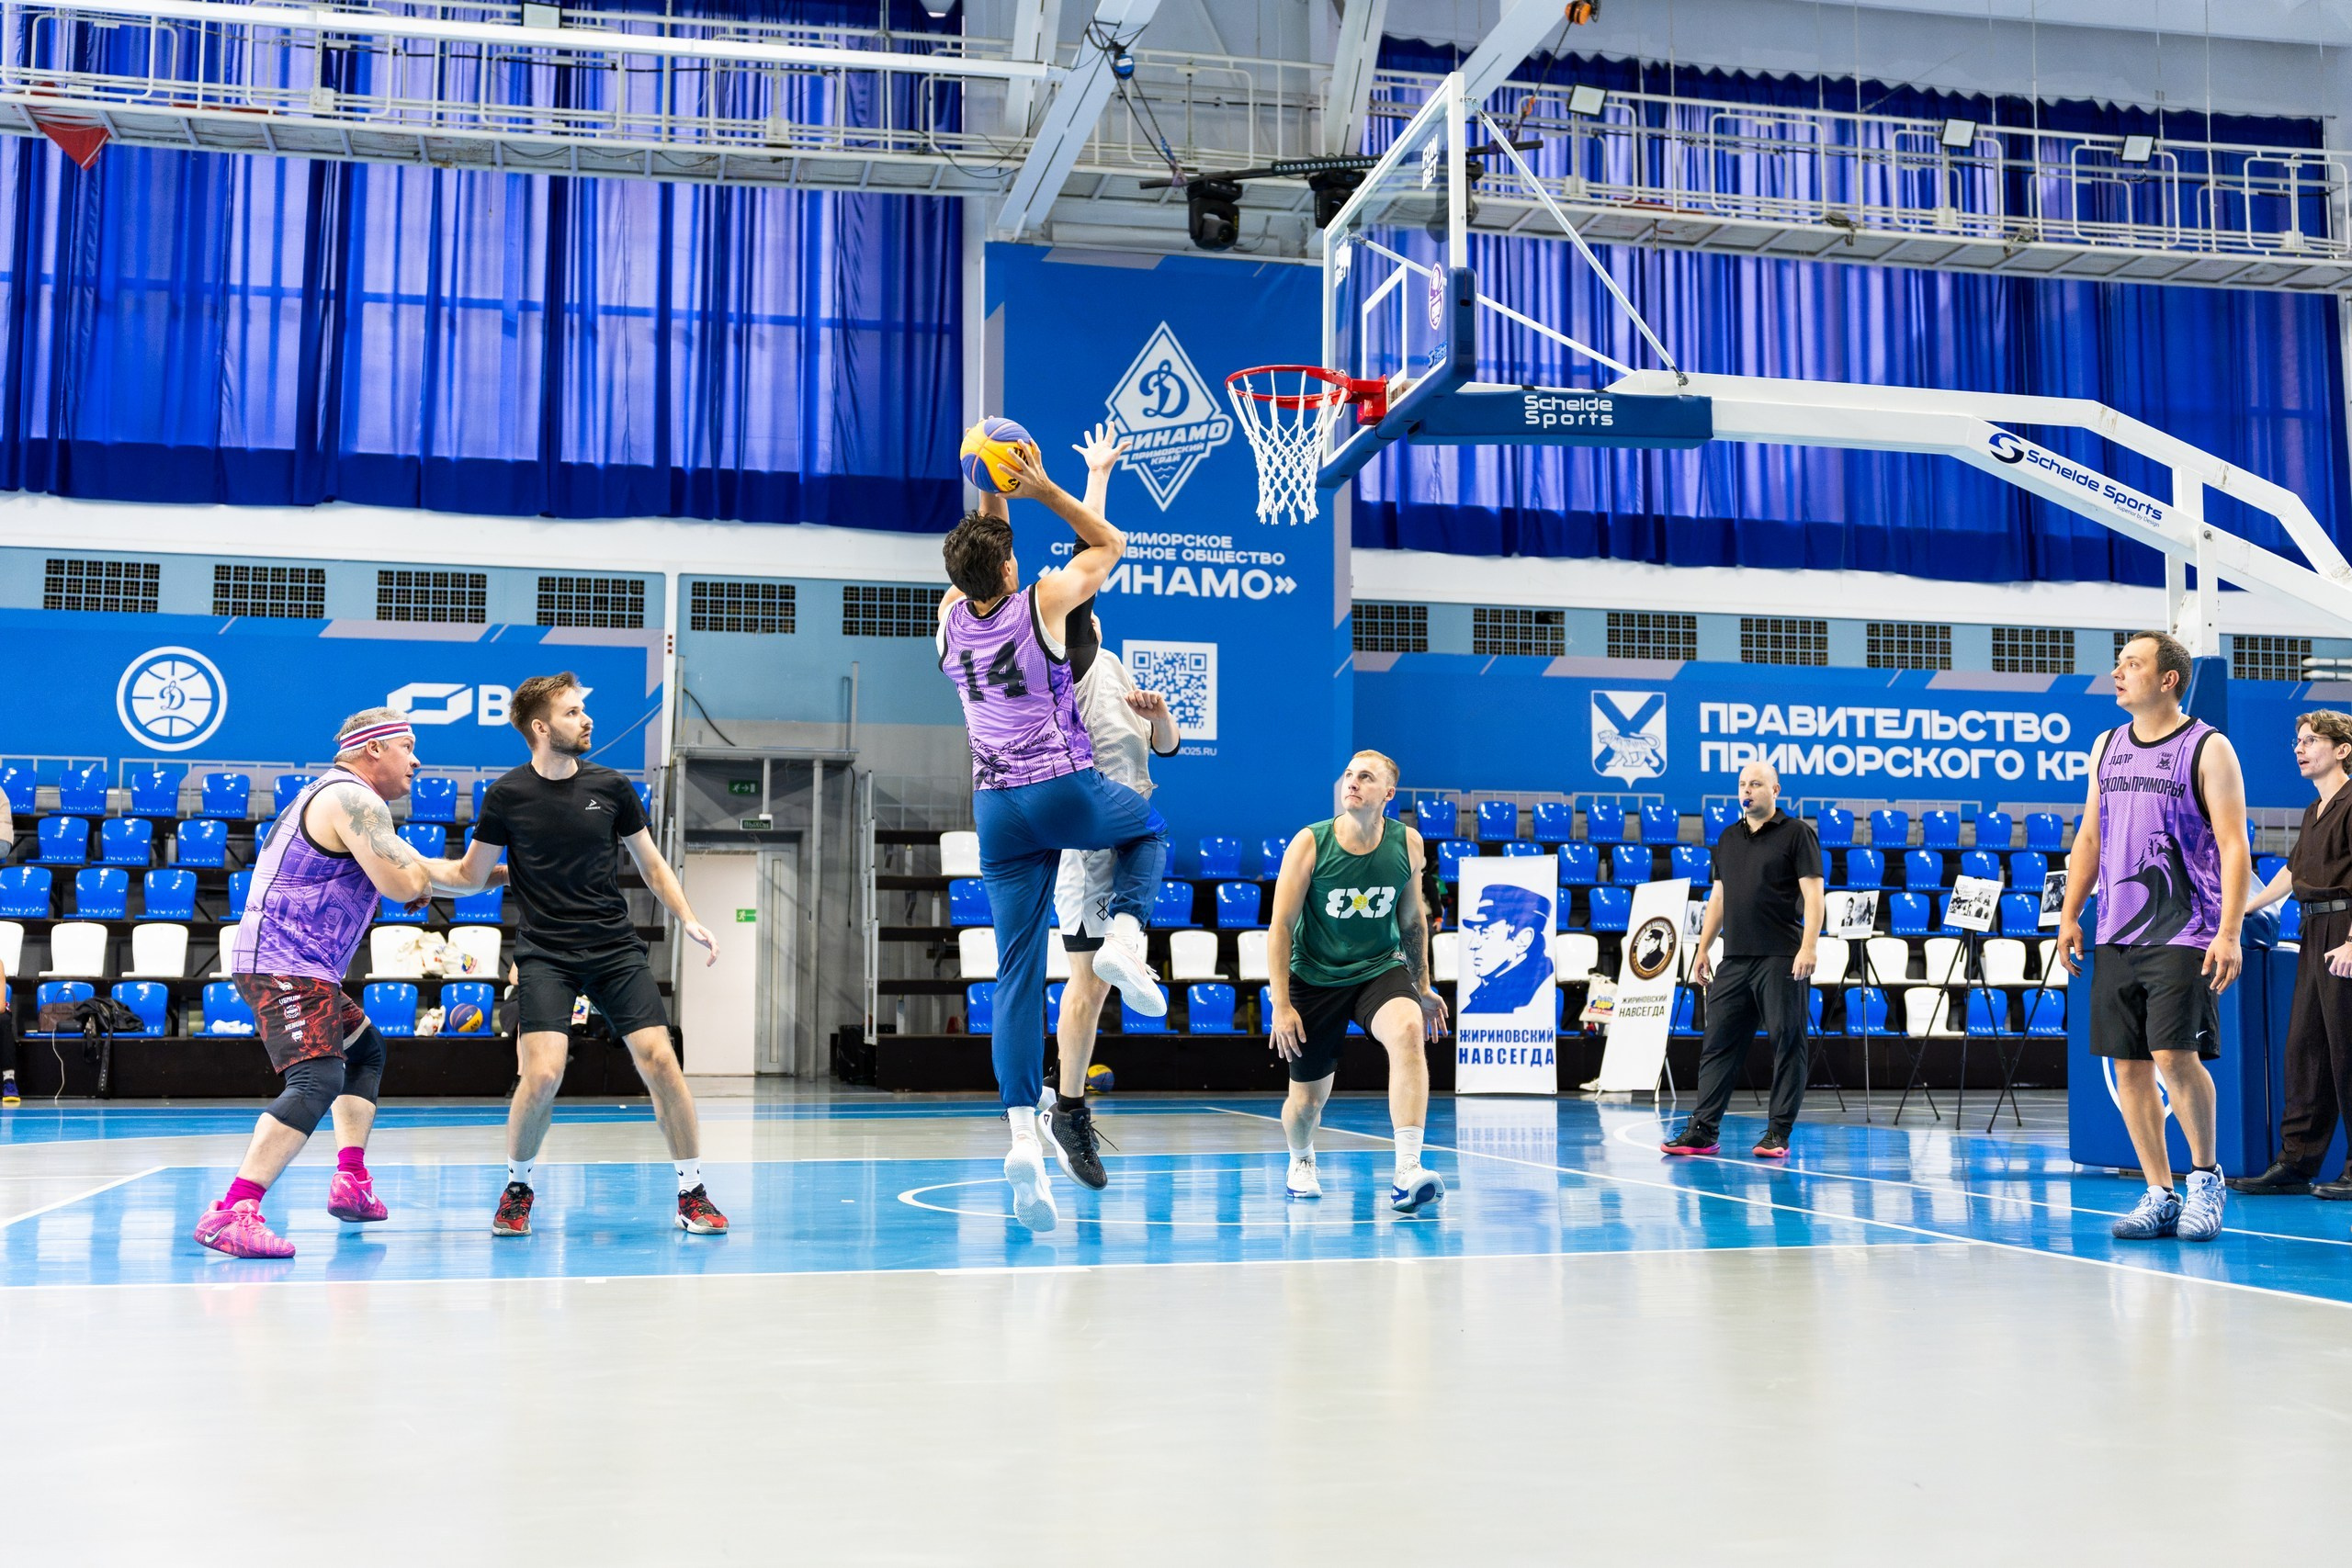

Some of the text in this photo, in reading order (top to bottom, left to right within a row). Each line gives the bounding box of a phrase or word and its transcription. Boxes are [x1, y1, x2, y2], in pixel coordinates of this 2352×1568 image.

[1422, 133, 1438, 169] FON
[1422, 155, 1438, 191] BET
[1523, 395, 1613, 412] Schelde
[1524, 410, 1614, 429] Sports
[1131, 442, 1204, 461] ПРИМОРСКИЙ
[1150, 454, 1181, 465] КРАЙ
[2026, 449, 2163, 521] Schelde Sports
[2116, 504, 2136, 517] Superior
[2143, 515, 2160, 528] Design
[1123, 532, 1232, 548] РИМОРСКОЕ
[1182, 548, 1285, 565] ОБЩЕСТВО
[958, 638, 1031, 704] 14
[1699, 702, 2071, 744] ПРАВИТЕЛЬСТВО
[1699, 740, 2089, 782] ПРИМОРСКОГО КР
[2109, 753, 2133, 766] ЛДПР
[2132, 776, 2187, 799] ПРИМОРЬЯ
[1622, 994, 1668, 1004] ЖИРИНОВСКИЙ
[1619, 1006, 1665, 1017] НАВСЕГДА
[285, 1019, 306, 1031] VENUM
[1459, 1027, 1554, 1043] ЖИРИНОВСКИЙ
[1458, 1048, 1554, 1067] НАВСЕГДА
